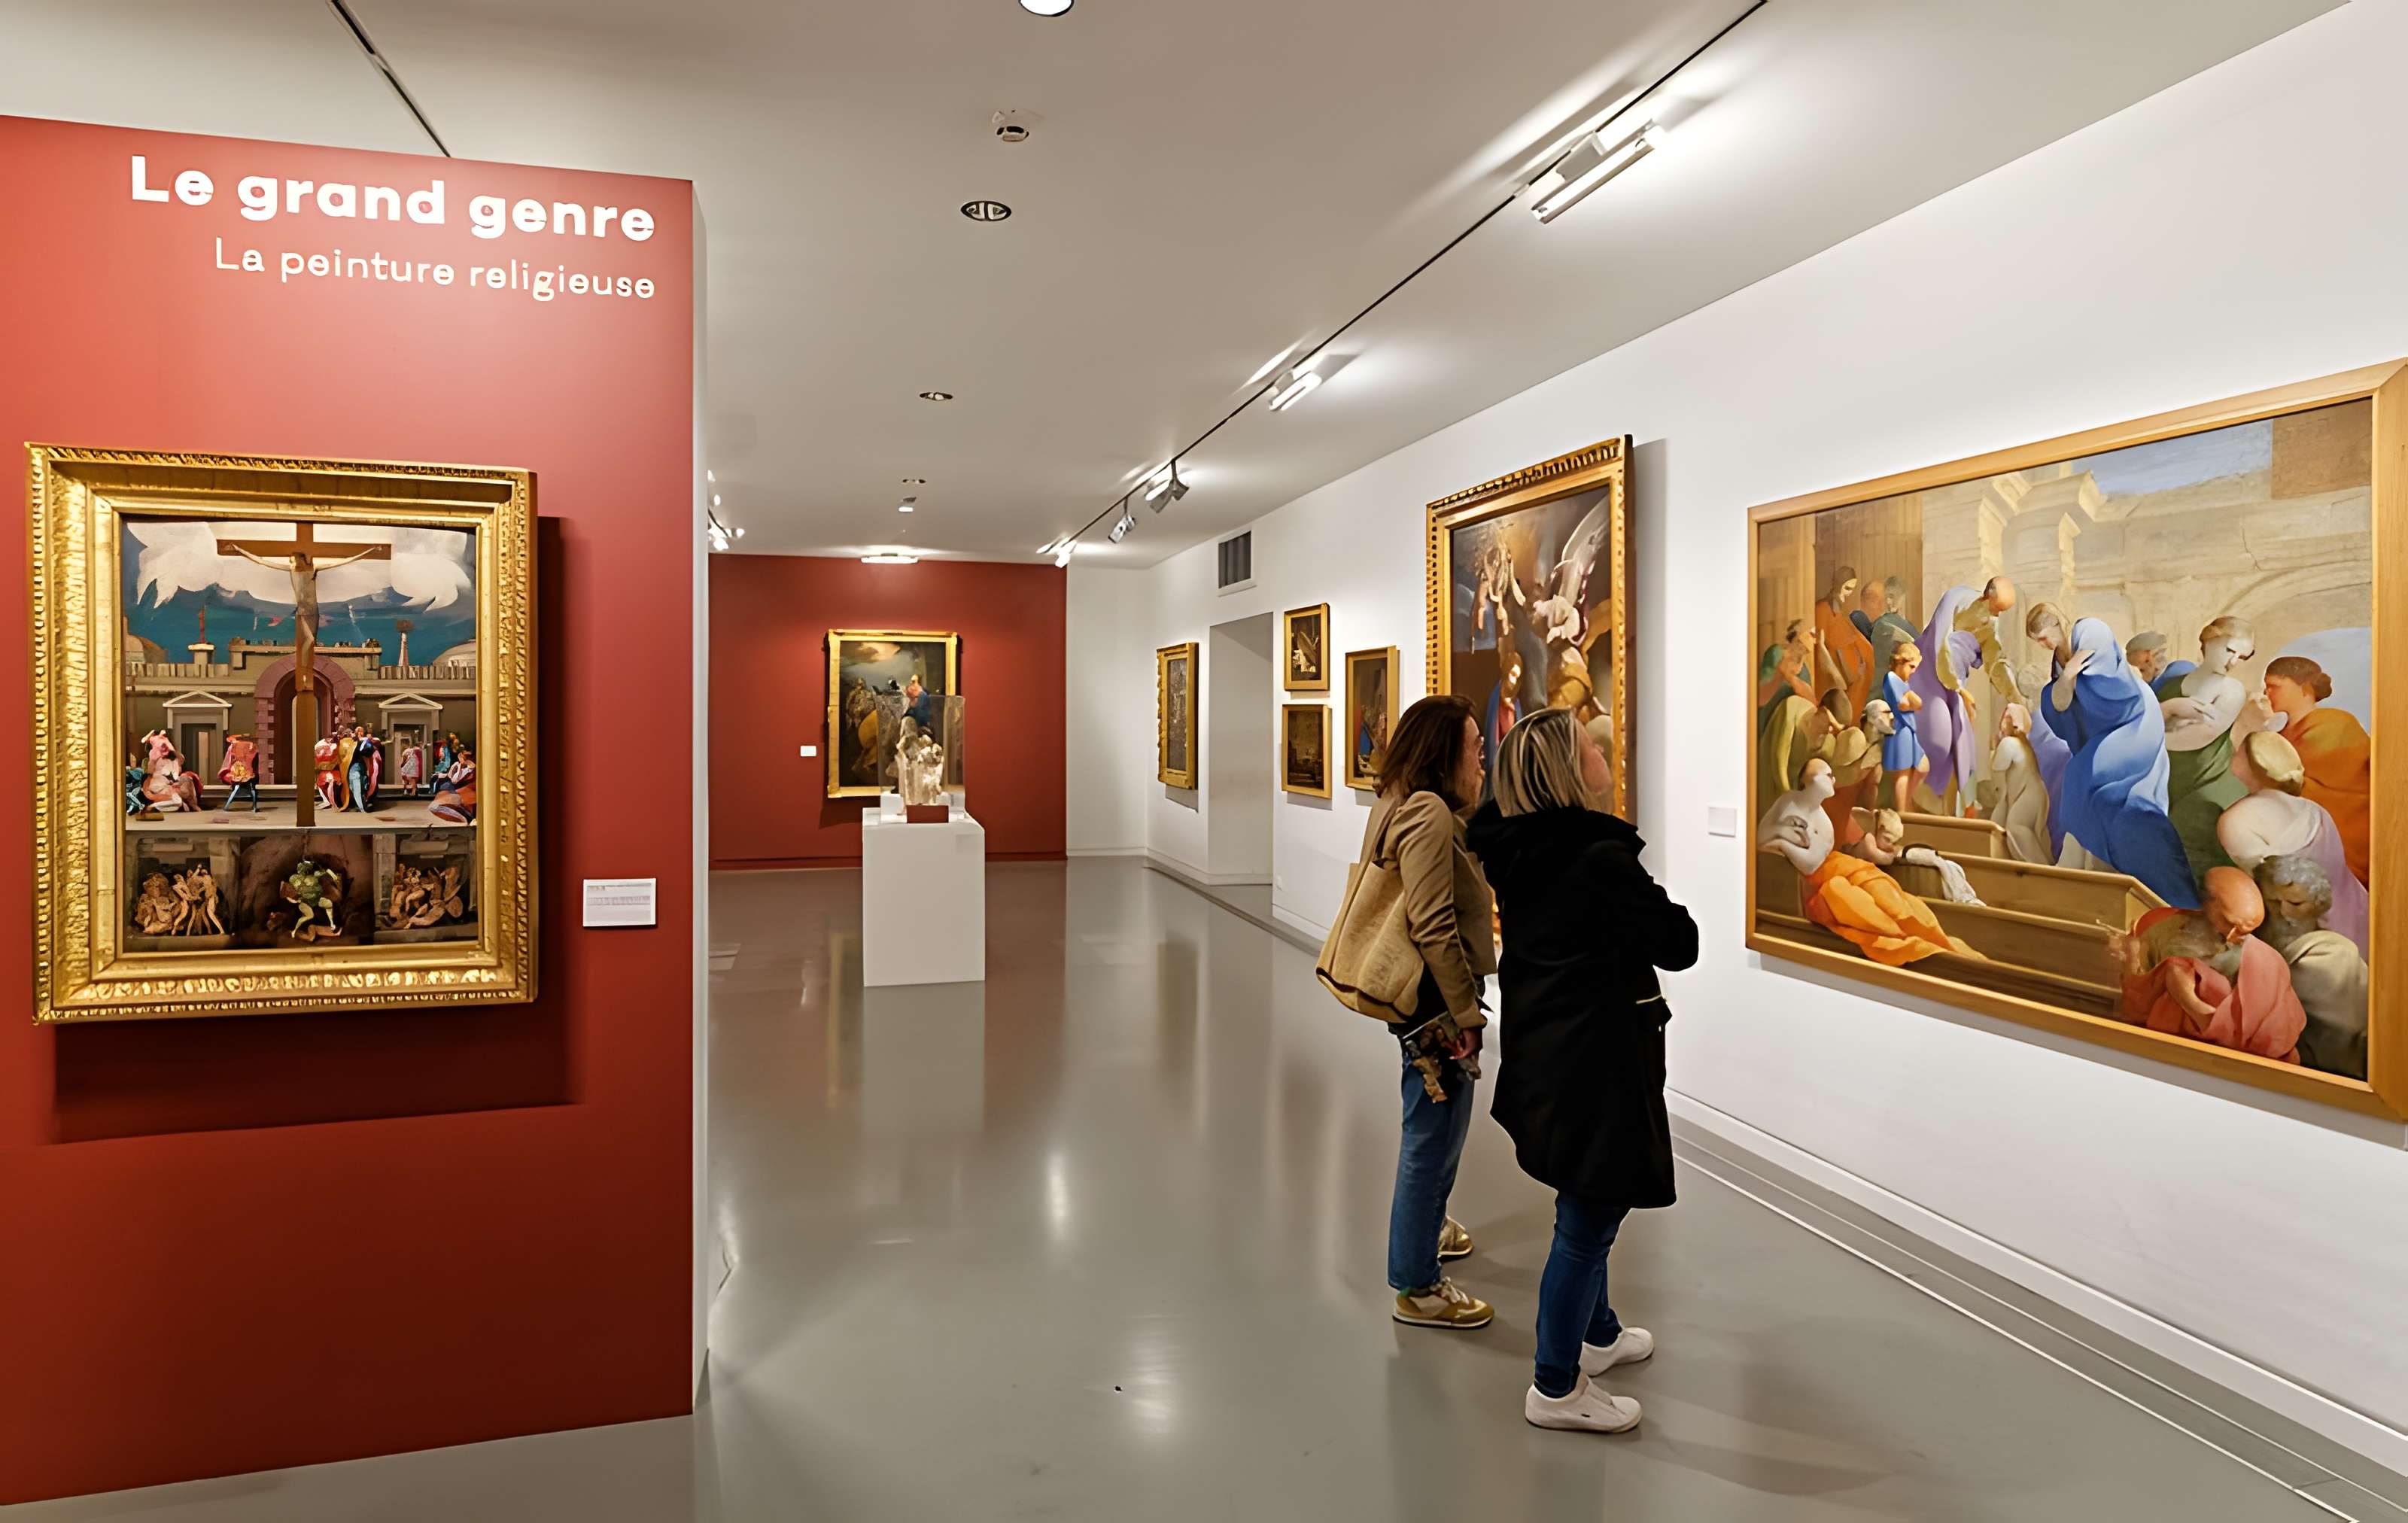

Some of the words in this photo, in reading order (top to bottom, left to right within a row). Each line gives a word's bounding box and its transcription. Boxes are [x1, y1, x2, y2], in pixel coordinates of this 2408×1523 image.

[132, 155, 214, 205] Le
[237, 175, 445, 224] grand
[469, 195, 655, 242] genre
[216, 237, 265, 272] La
[281, 249, 455, 285] peinture
[470, 259, 655, 302] religieuse
